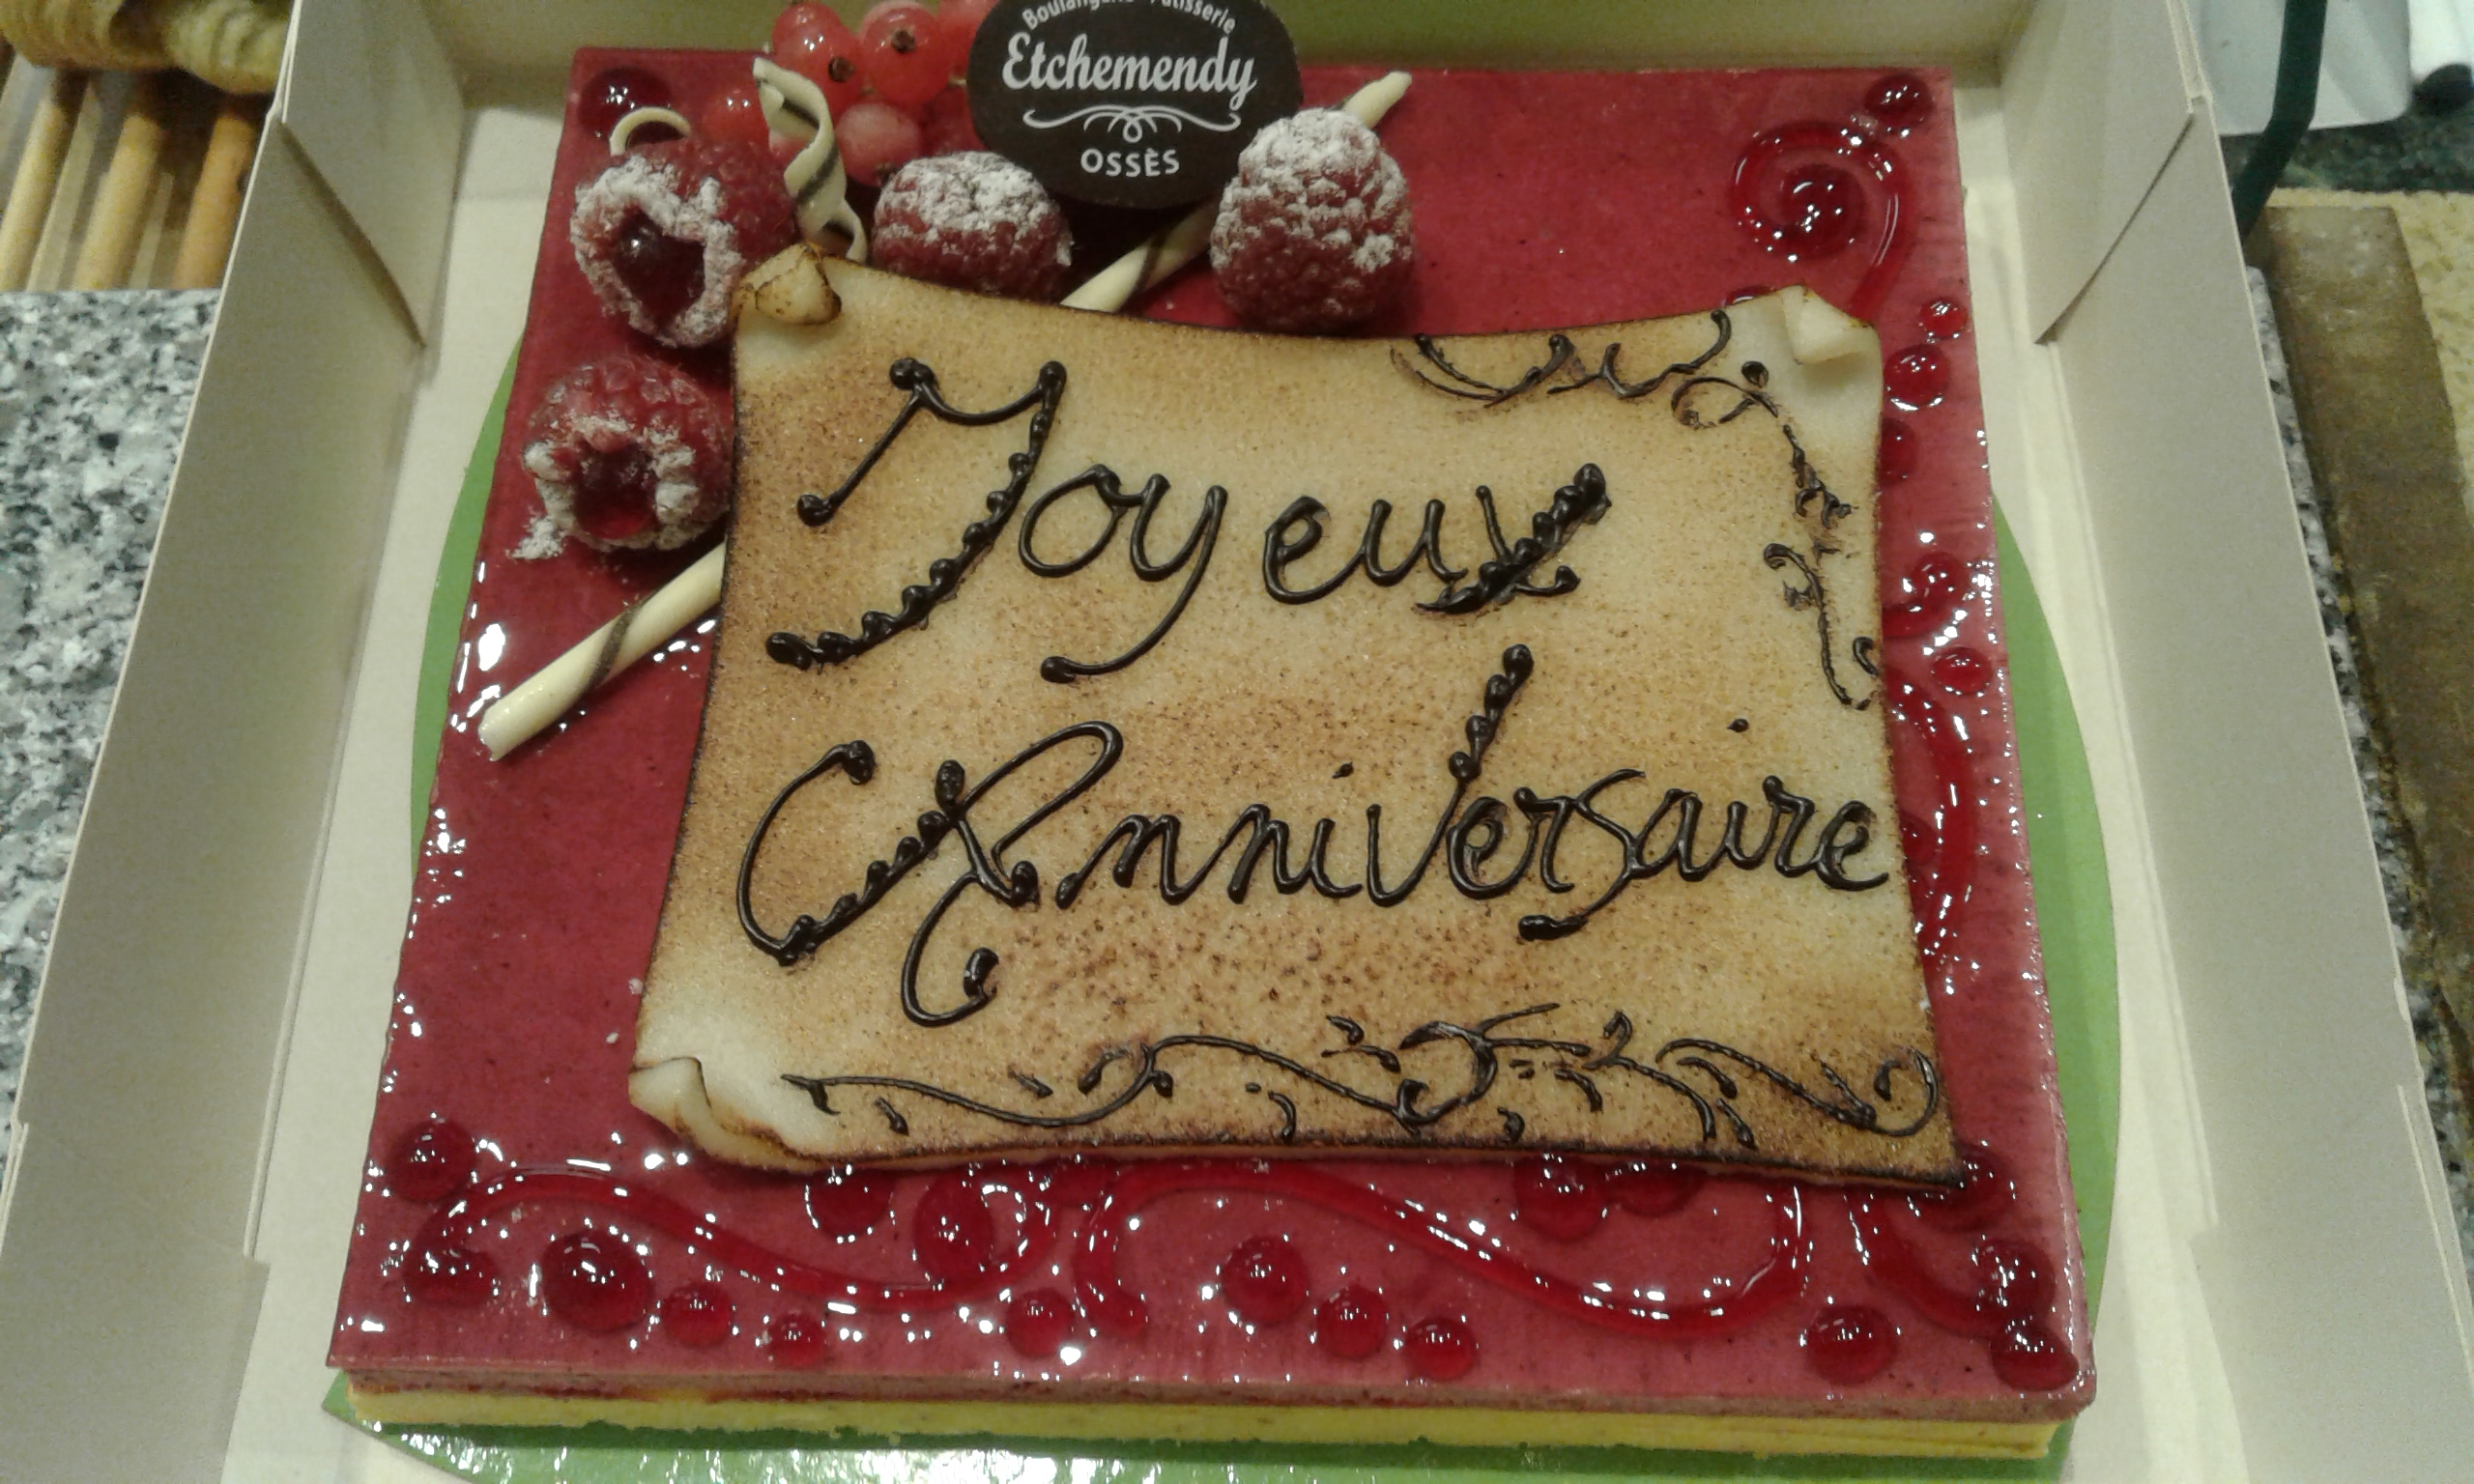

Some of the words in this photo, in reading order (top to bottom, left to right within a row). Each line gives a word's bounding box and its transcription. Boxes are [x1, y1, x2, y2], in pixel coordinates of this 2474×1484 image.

[1002, 32, 1256, 111] Etchemendy
[1080, 148, 1180, 178] OSSÈS
[766, 358, 1612, 684] Joyeux
